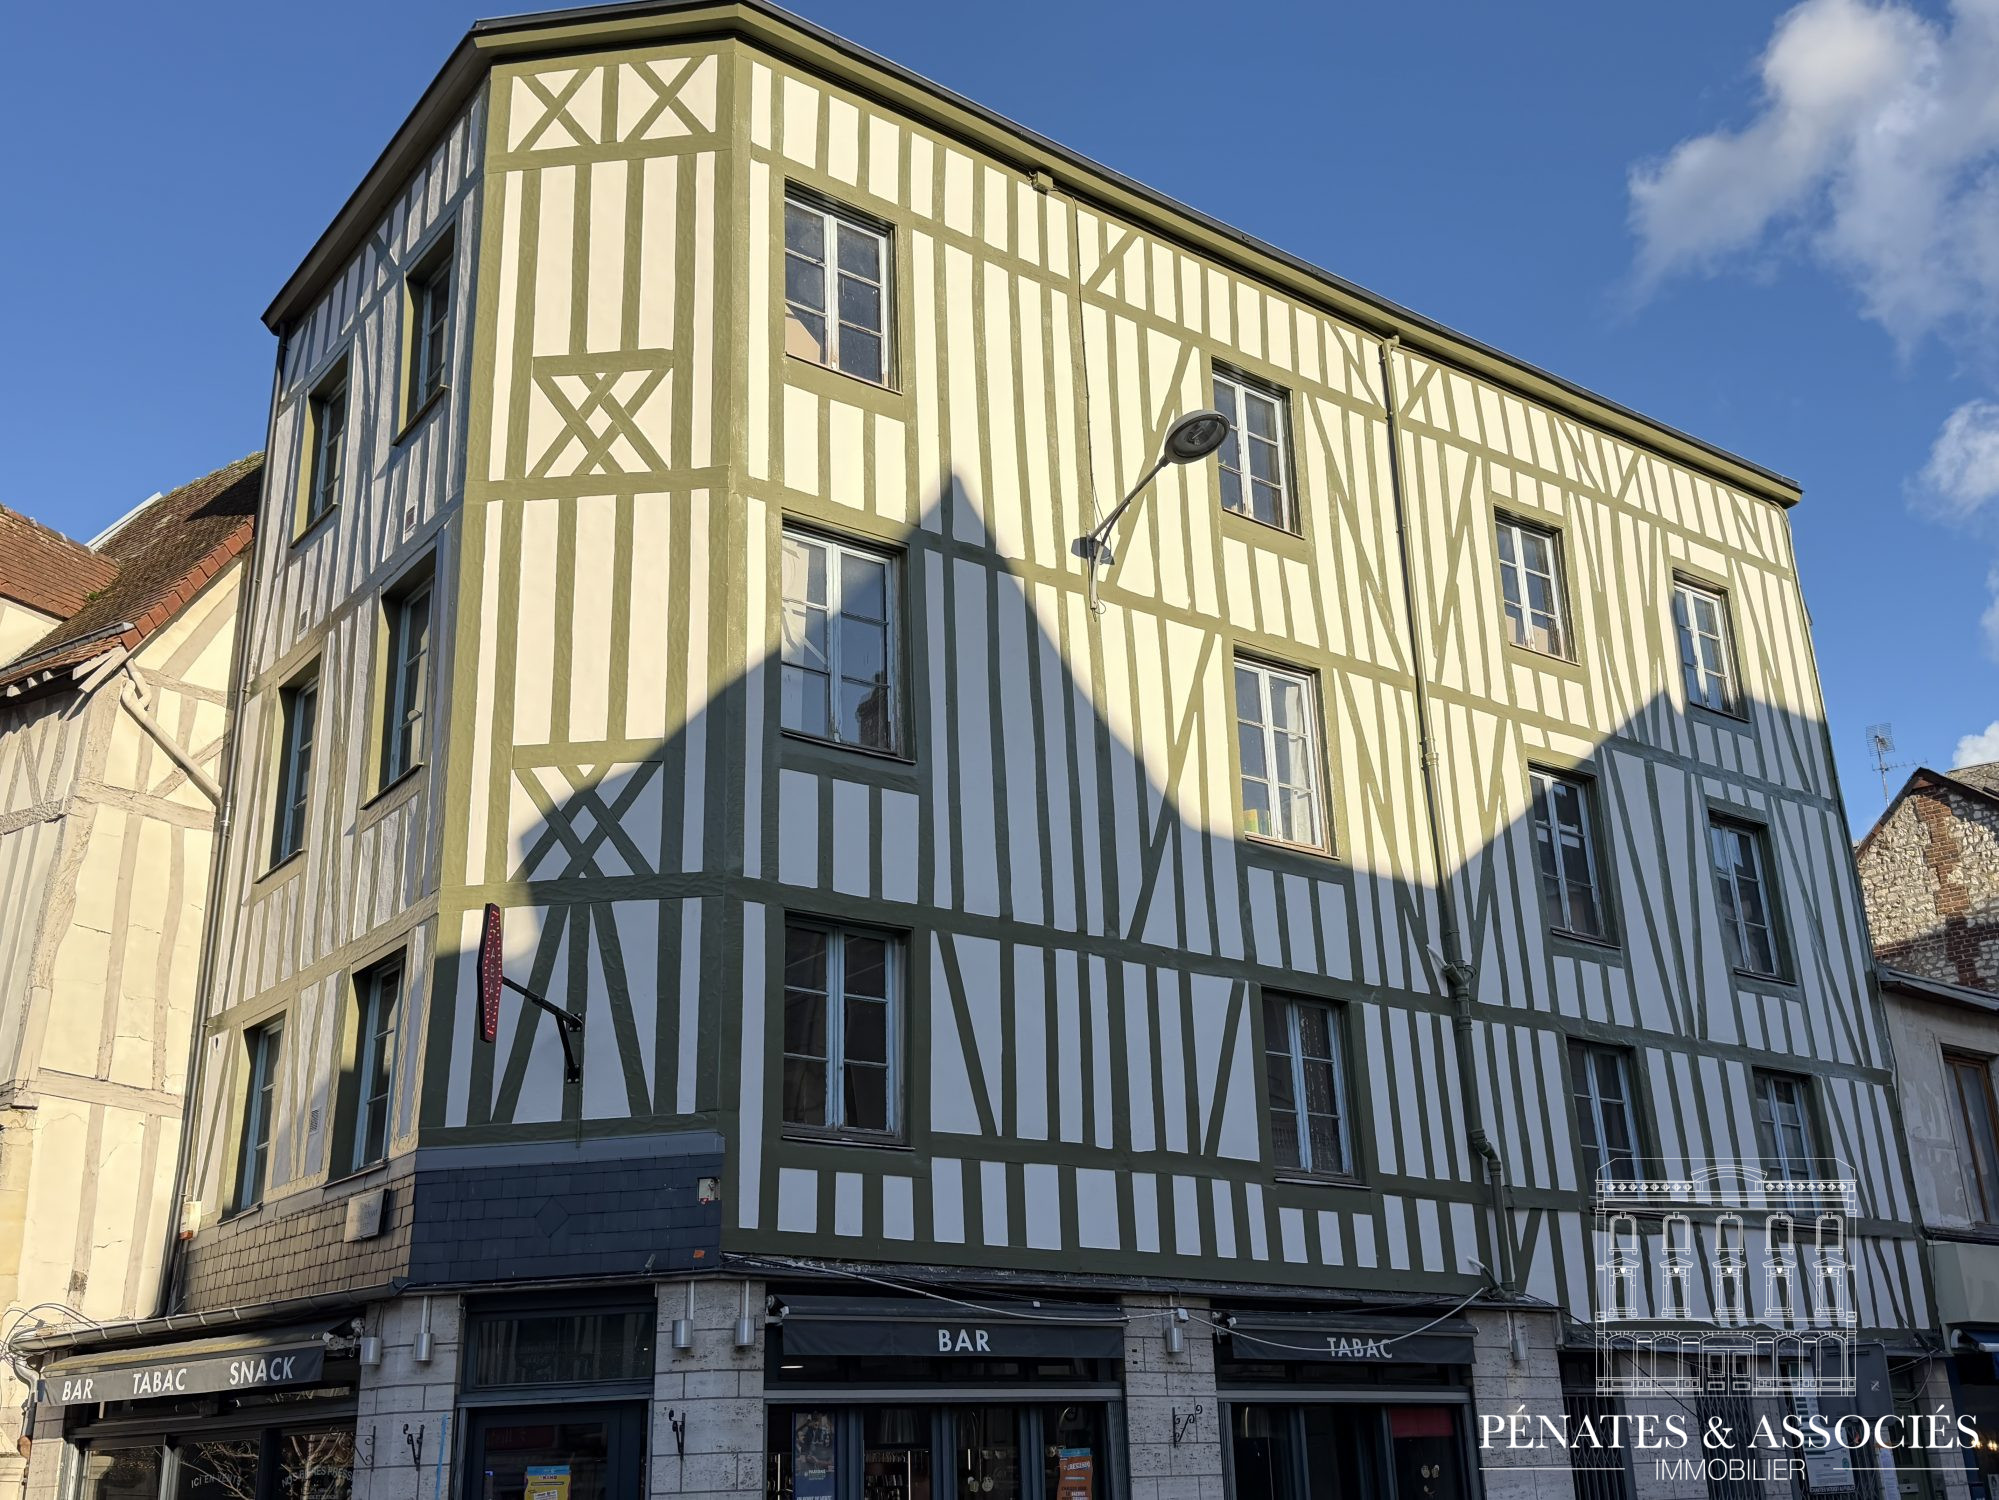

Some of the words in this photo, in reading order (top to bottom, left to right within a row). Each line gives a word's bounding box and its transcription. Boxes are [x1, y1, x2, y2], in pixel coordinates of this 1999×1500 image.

[938, 1328, 992, 1352] BAR
[1326, 1336, 1393, 1359] TABAC
[61, 1378, 94, 1401] BAR
[132, 1368, 188, 1395] TABAC
[229, 1356, 296, 1386] SNACK
